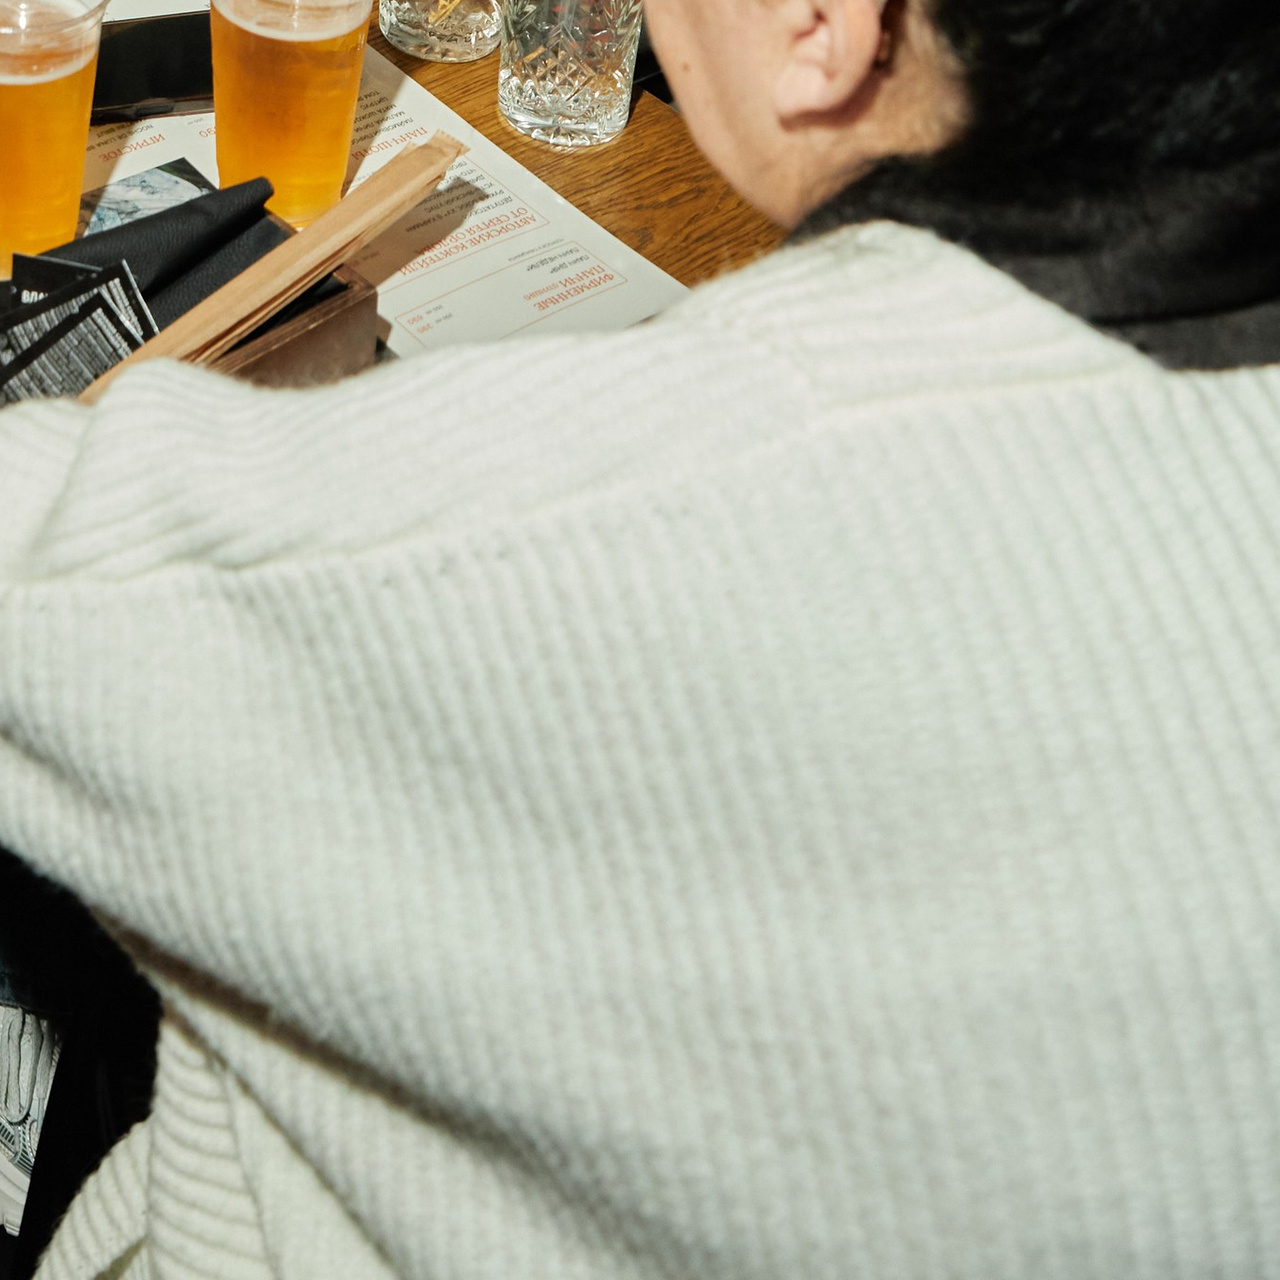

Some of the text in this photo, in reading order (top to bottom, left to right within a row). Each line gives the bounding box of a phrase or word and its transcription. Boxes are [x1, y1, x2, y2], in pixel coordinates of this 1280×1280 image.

[99, 132, 165, 163] ИГРИСТОЕ
[414, 206, 528, 256] ОТ СЕРГЕЯ ОРЛОВА
[465, 214, 536, 247] АВТОРСКИЕ
[399, 241, 468, 276] КОКТЕЙЛИ
[533, 273, 615, 312] ФИРМЕННЫЕ
[559, 265, 605, 288] ПАНЧИ
